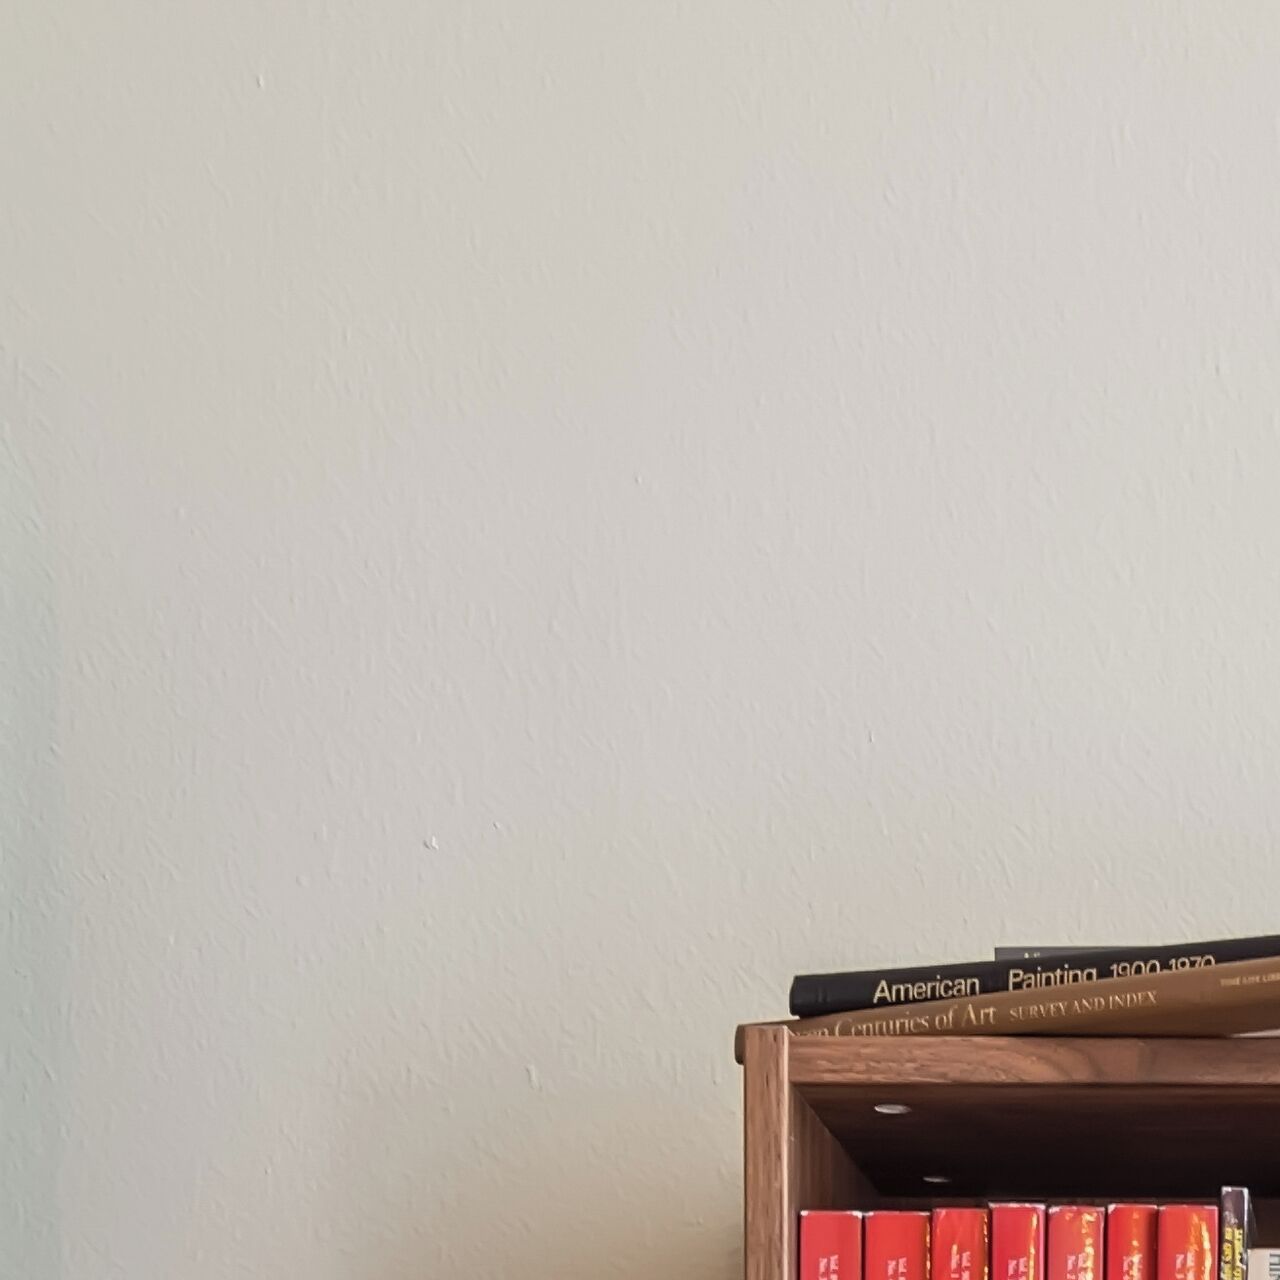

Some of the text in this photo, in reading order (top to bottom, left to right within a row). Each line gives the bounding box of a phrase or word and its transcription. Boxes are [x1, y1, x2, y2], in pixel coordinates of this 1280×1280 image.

[872, 974, 980, 1004] American
[1008, 963, 1098, 991] Painting
[935, 1004, 959, 1029] of
[962, 1002, 996, 1028] Art
[1008, 990, 1158, 1021] SURVEY AND INDEX
